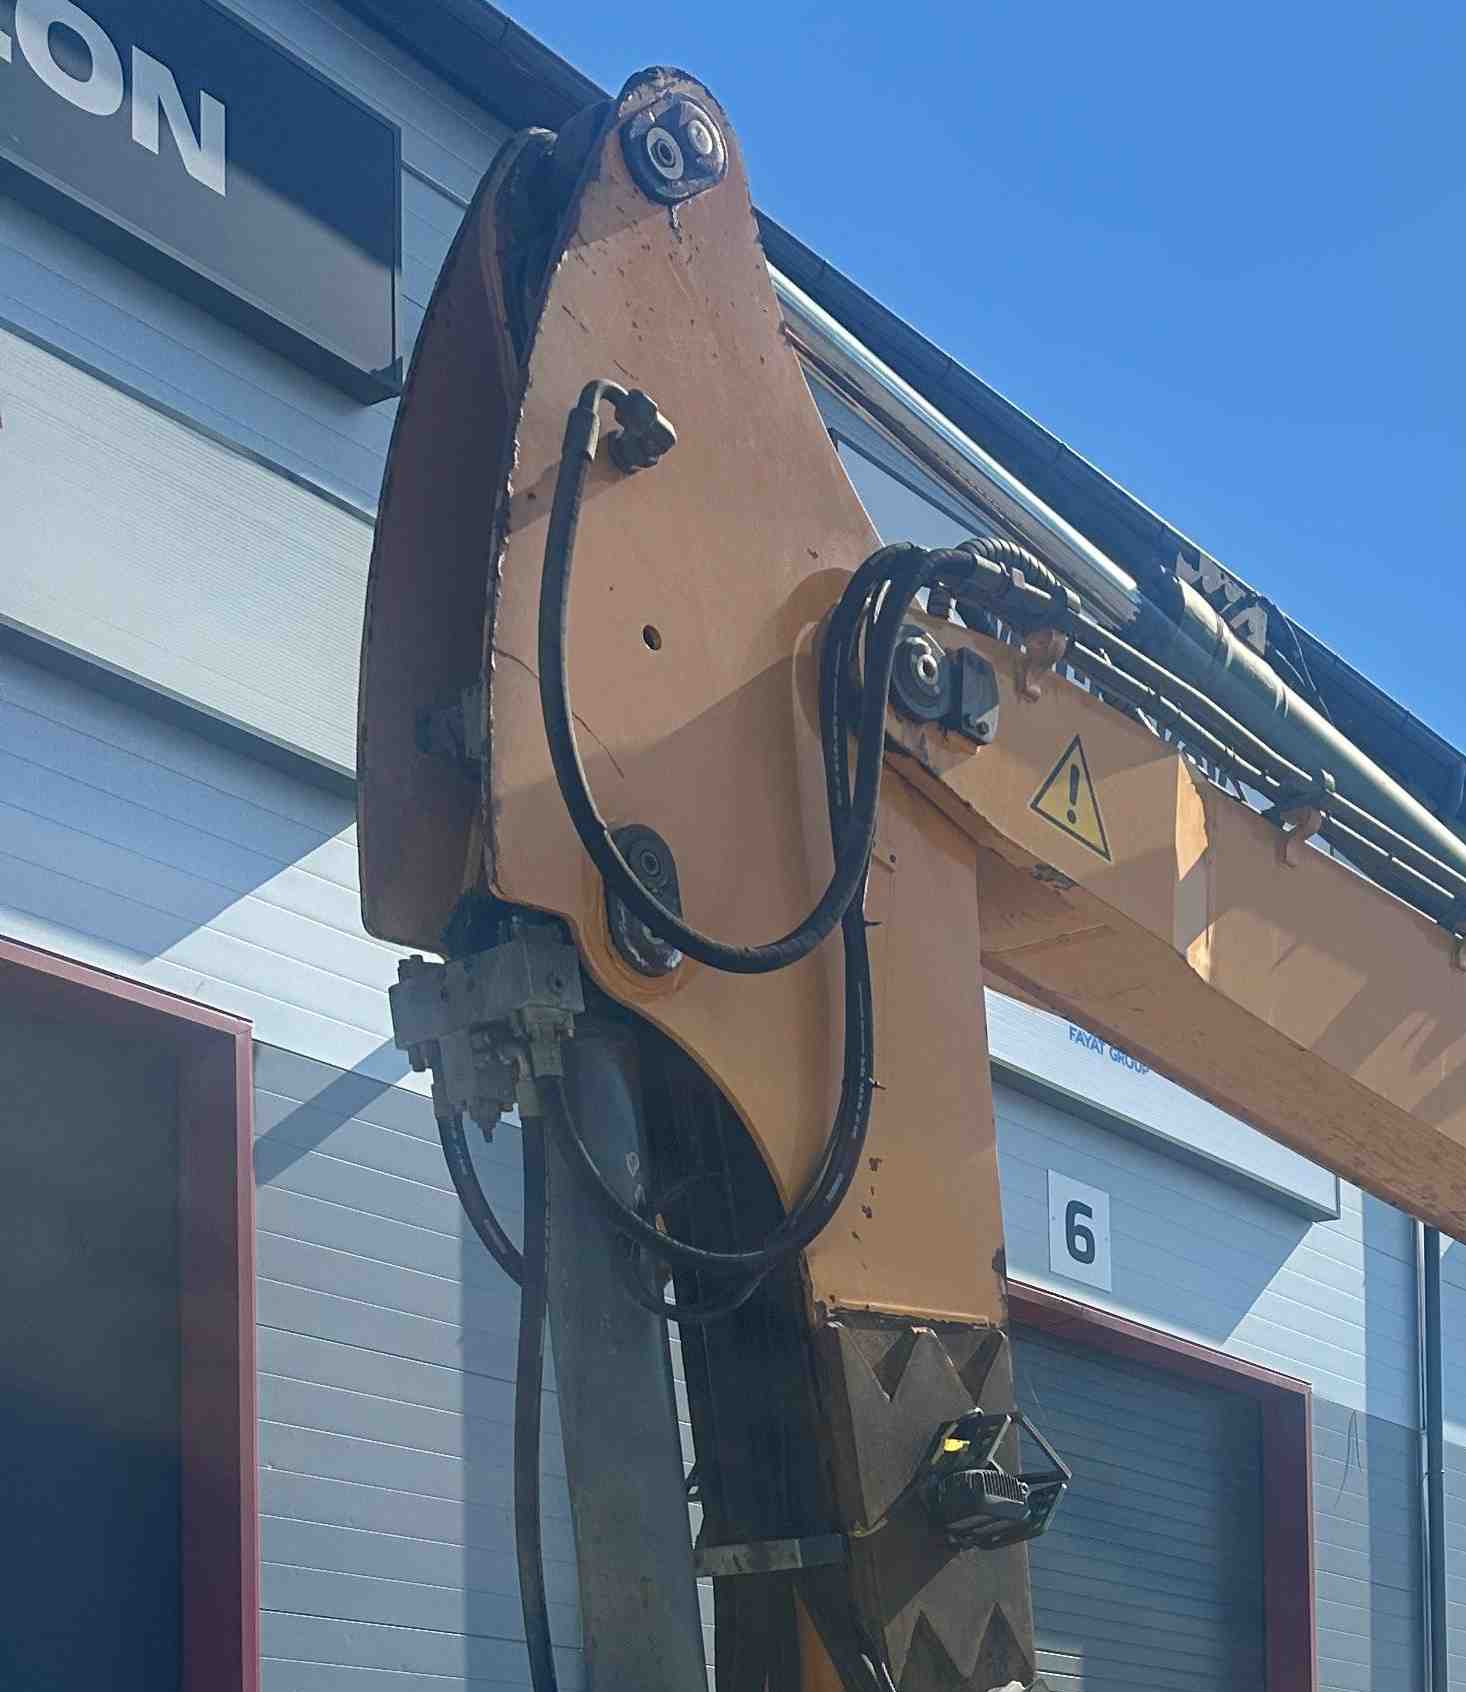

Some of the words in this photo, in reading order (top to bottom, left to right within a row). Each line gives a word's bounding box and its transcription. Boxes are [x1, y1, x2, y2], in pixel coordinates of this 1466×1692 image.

[0, 0, 226, 197] ON
[1068, 1025, 1105, 1056] FAYAT
[1065, 1200, 1096, 1264] 6
